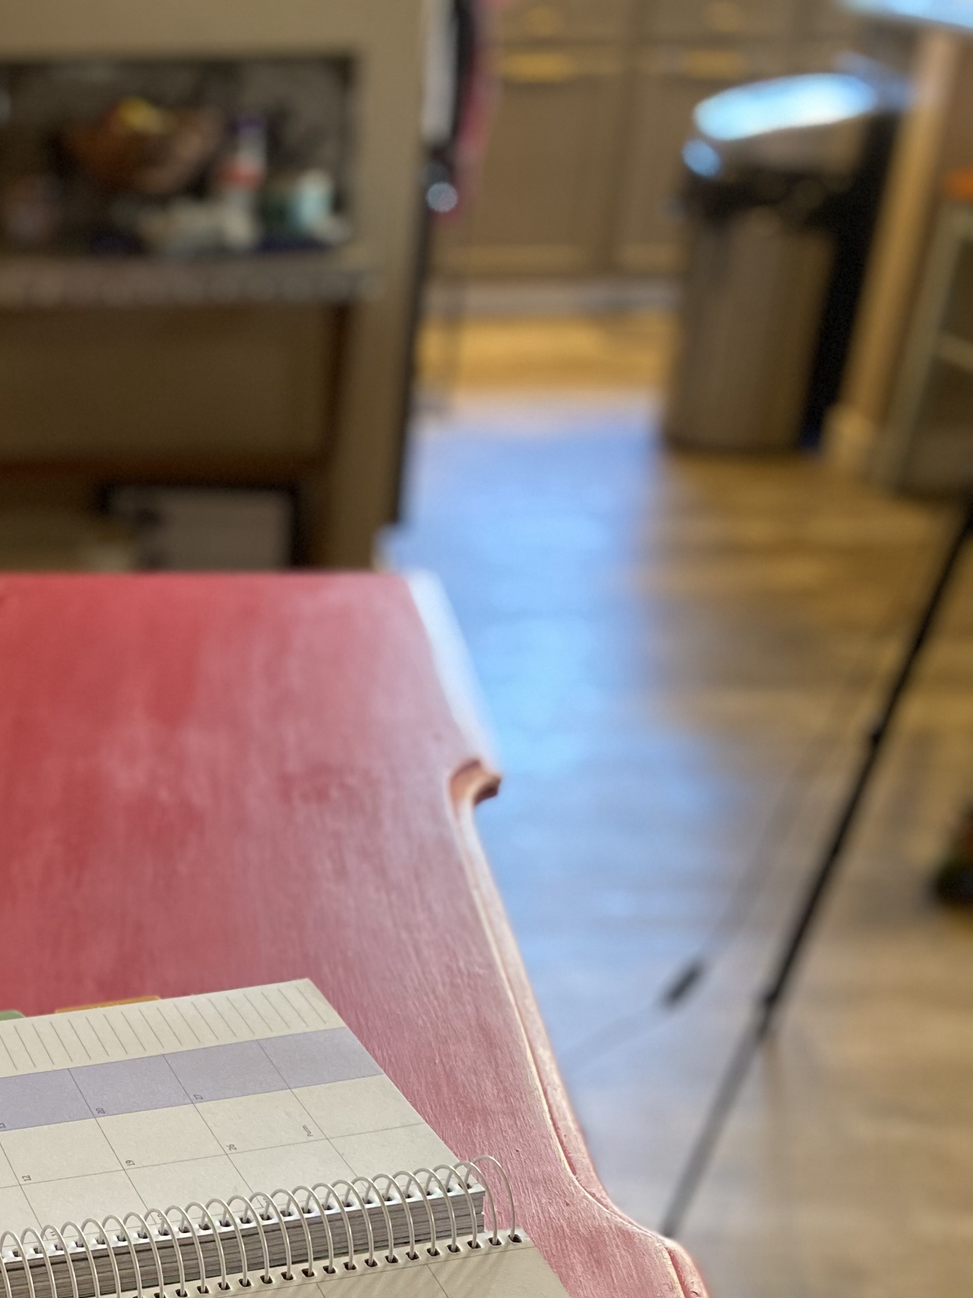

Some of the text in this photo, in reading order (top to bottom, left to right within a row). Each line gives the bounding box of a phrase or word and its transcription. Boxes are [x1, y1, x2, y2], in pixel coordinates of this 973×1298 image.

[226, 1143, 238, 1152] 26
[125, 1159, 136, 1167] 19
[21, 1174, 33, 1182] 12
